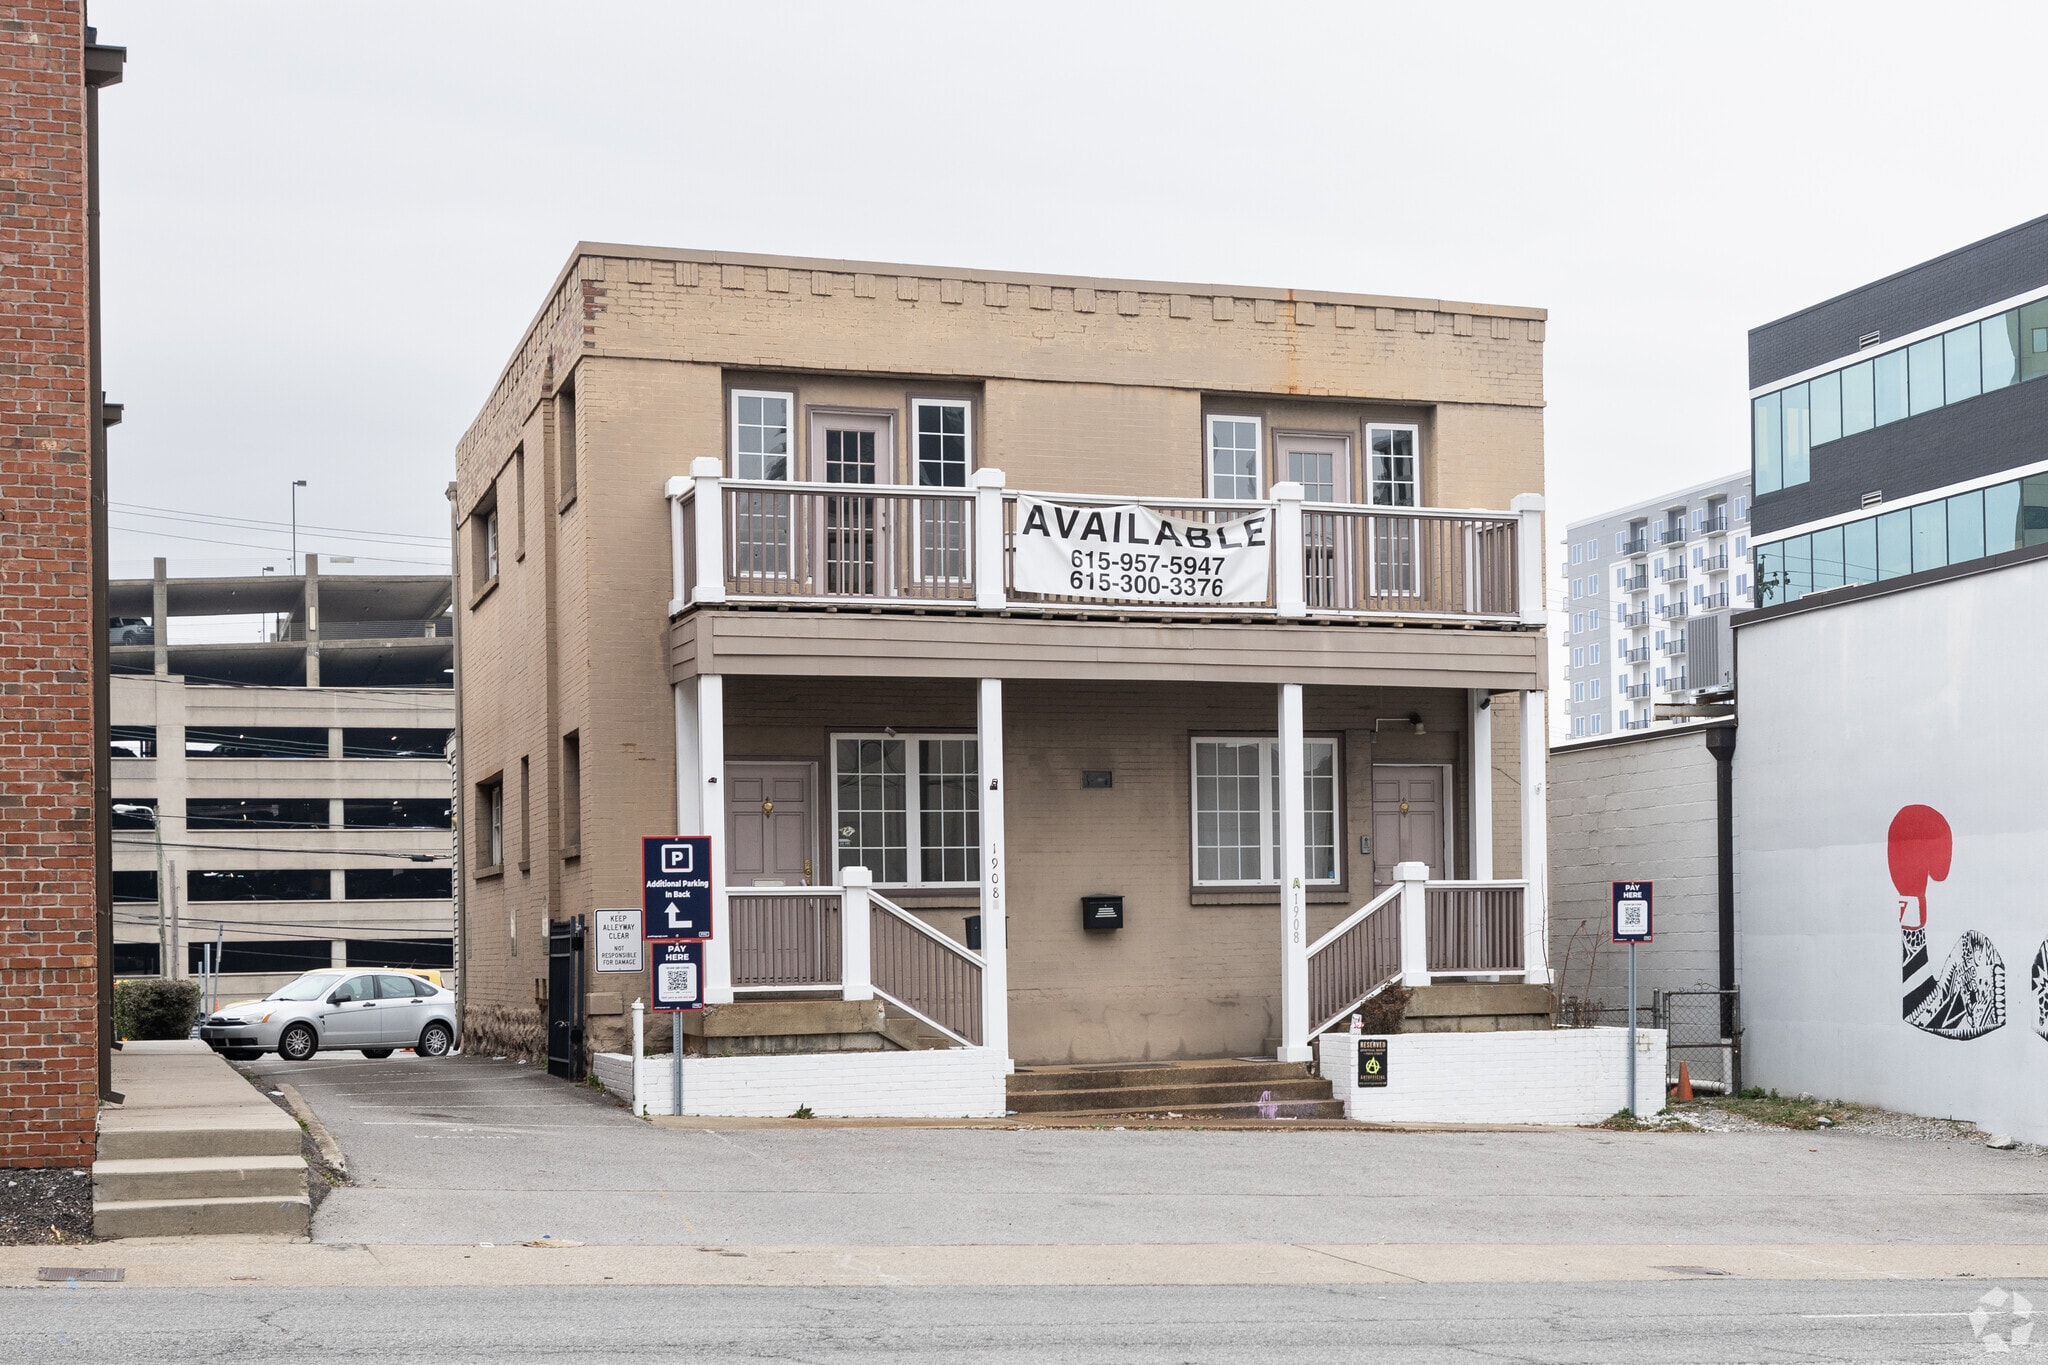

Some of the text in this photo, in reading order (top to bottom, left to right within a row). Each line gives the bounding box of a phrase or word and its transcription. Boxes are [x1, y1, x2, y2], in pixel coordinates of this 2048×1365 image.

[1022, 504, 1266, 549] AVAILABLE
[1071, 549, 1226, 576] 615-957-5947
[1069, 570, 1224, 597] 615-300-3376
[671, 851, 684, 866] P
[991, 842, 1000, 899] 1908
[646, 879, 709, 889] Additional Parking
[665, 890, 691, 898] In Back
[608, 932, 630, 940] CLEAR
[667, 945, 687, 953] PAY
[665, 953, 689, 961] HERE
